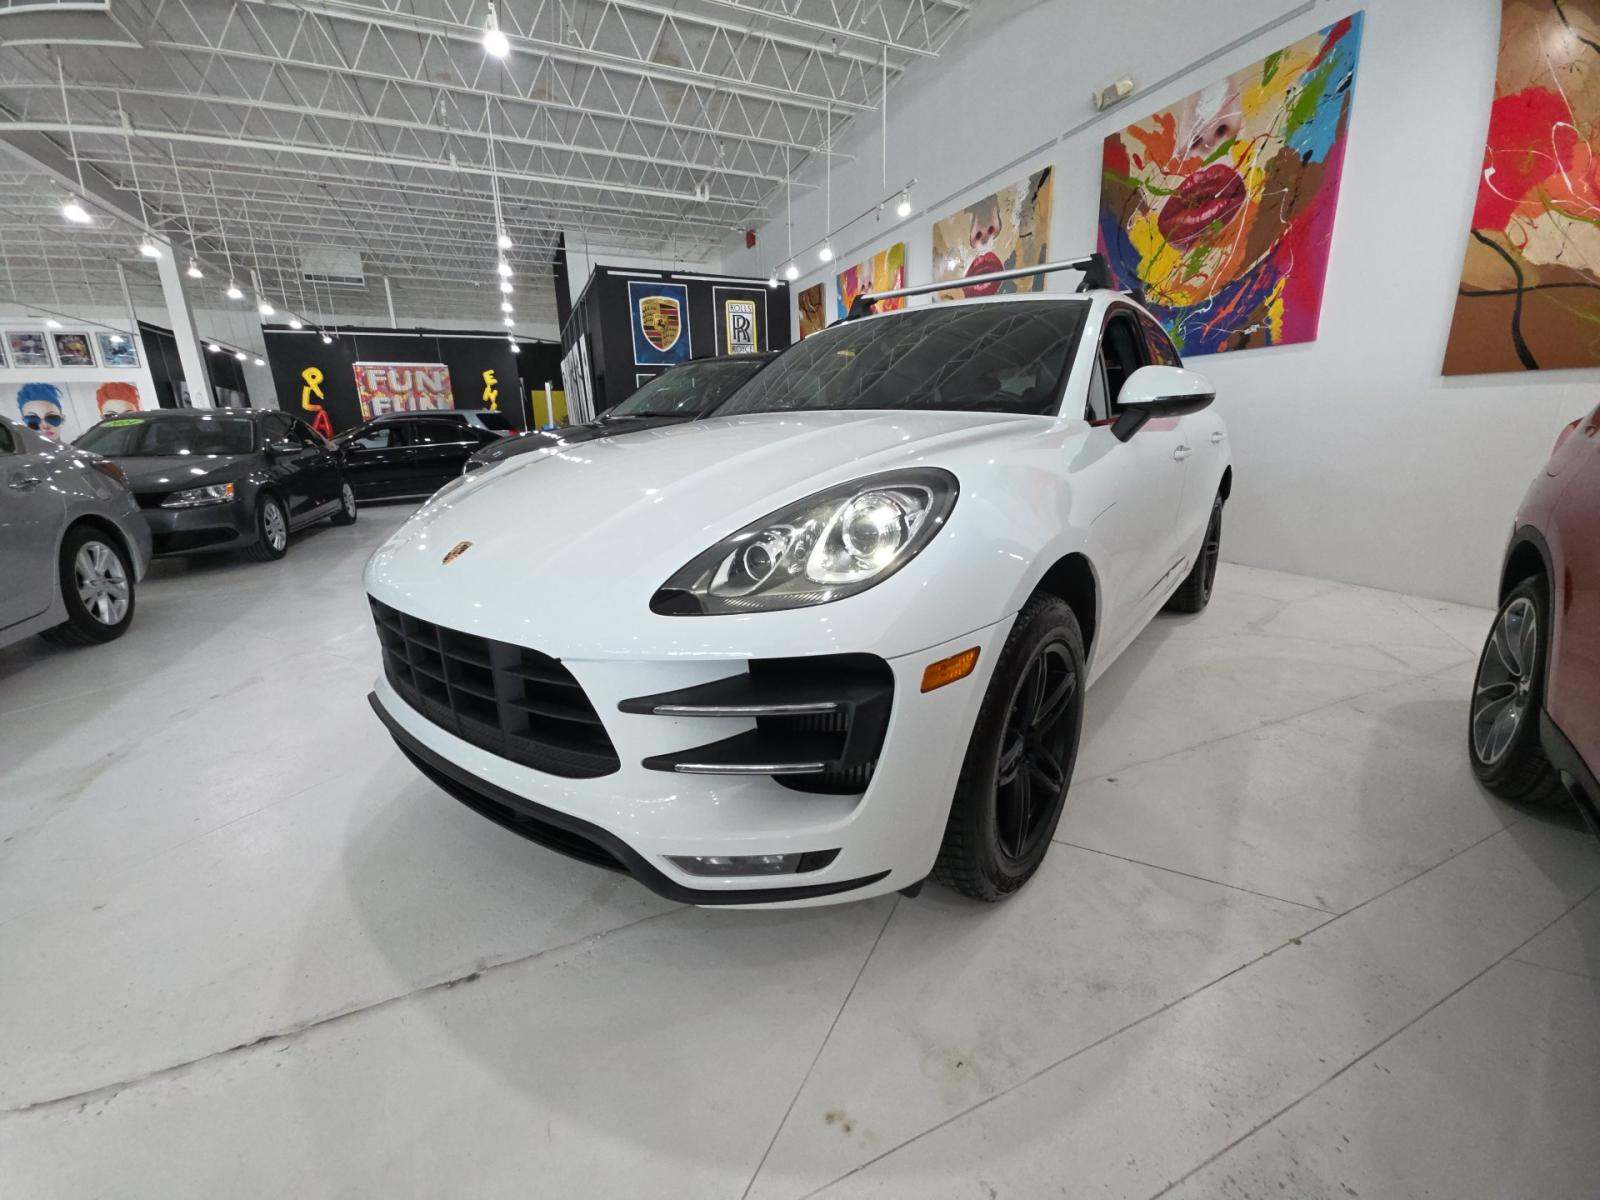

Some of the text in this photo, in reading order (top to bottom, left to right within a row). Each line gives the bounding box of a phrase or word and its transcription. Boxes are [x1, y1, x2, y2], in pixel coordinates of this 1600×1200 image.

[732, 314, 751, 343] RR
[366, 368, 444, 393] FUN
[372, 393, 450, 417] FUN
